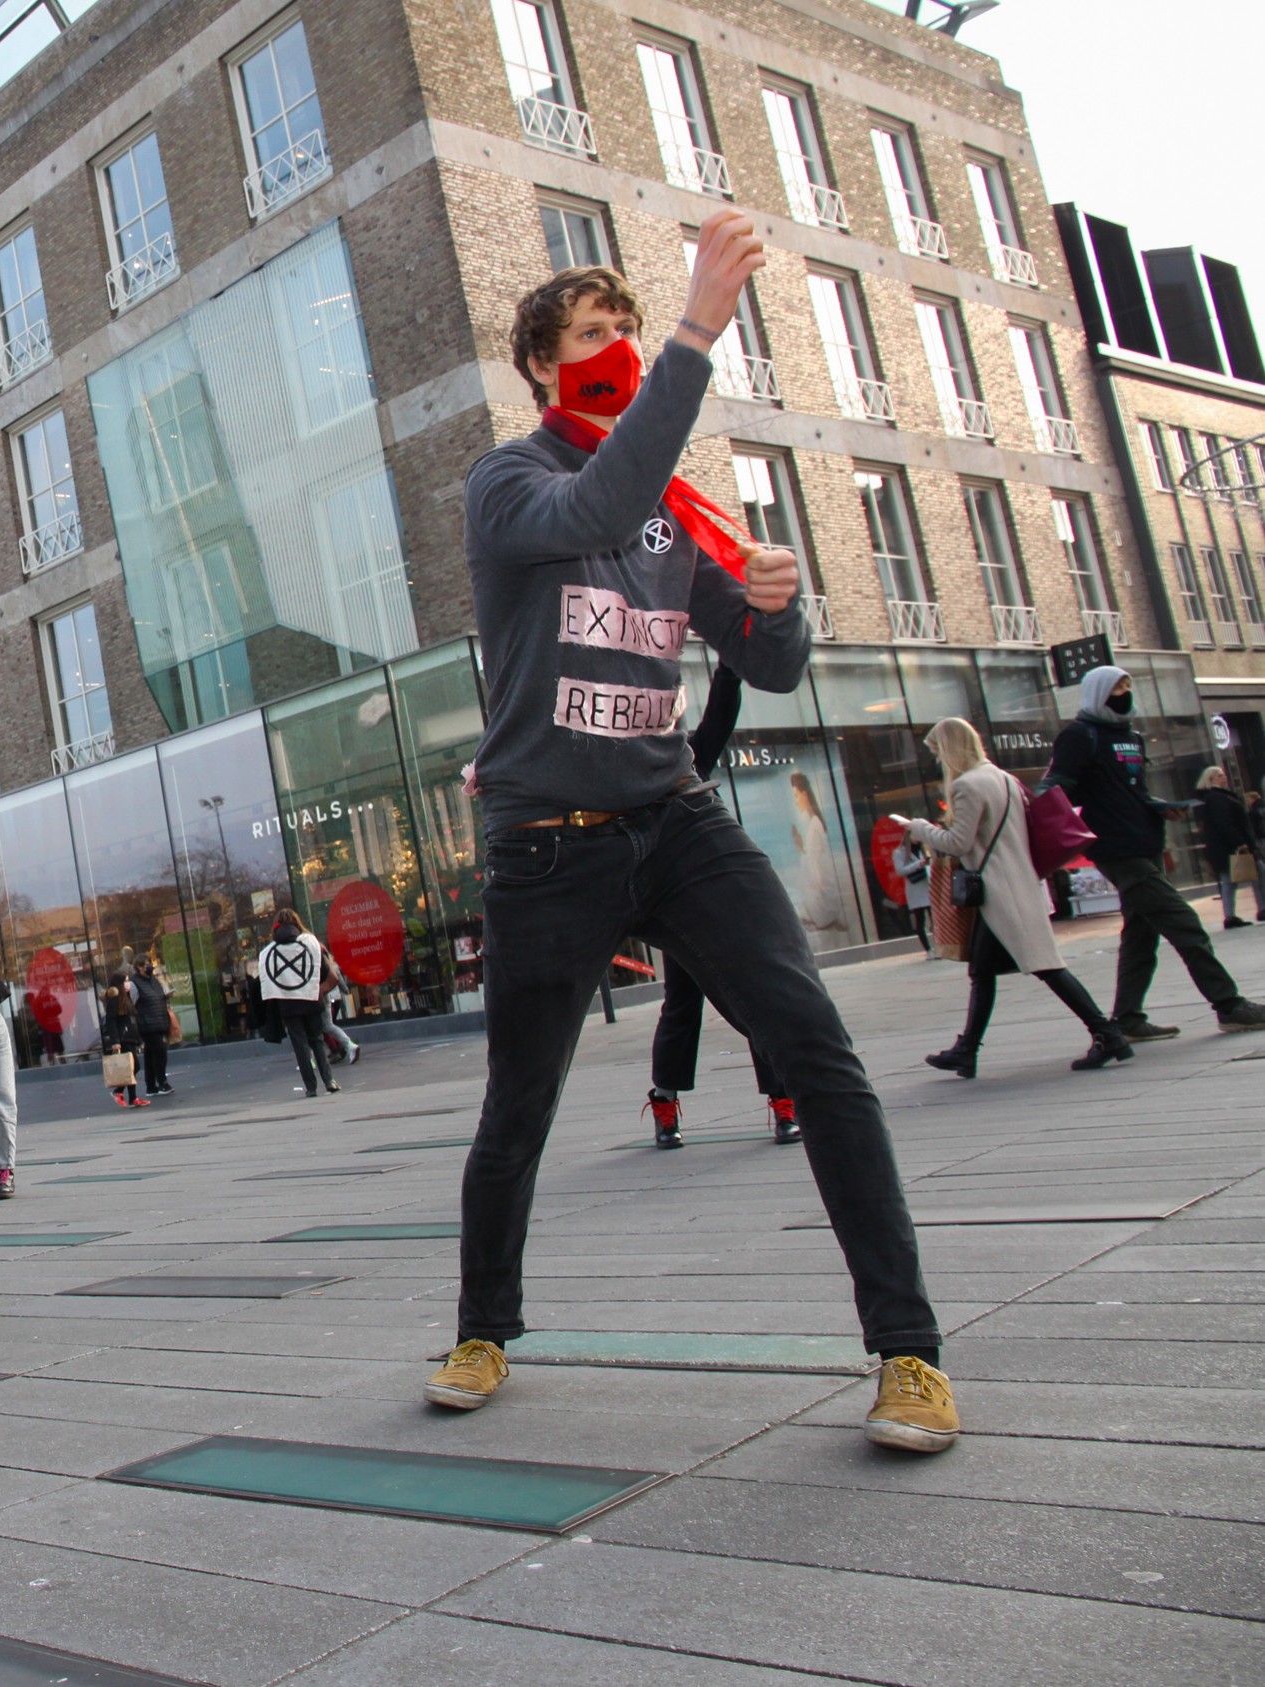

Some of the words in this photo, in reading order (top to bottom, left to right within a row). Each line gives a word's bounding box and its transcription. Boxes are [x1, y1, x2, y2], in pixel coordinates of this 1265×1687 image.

[342, 901, 379, 915] DECEMBER
[358, 917, 371, 928] dag
[373, 915, 383, 923] tot
